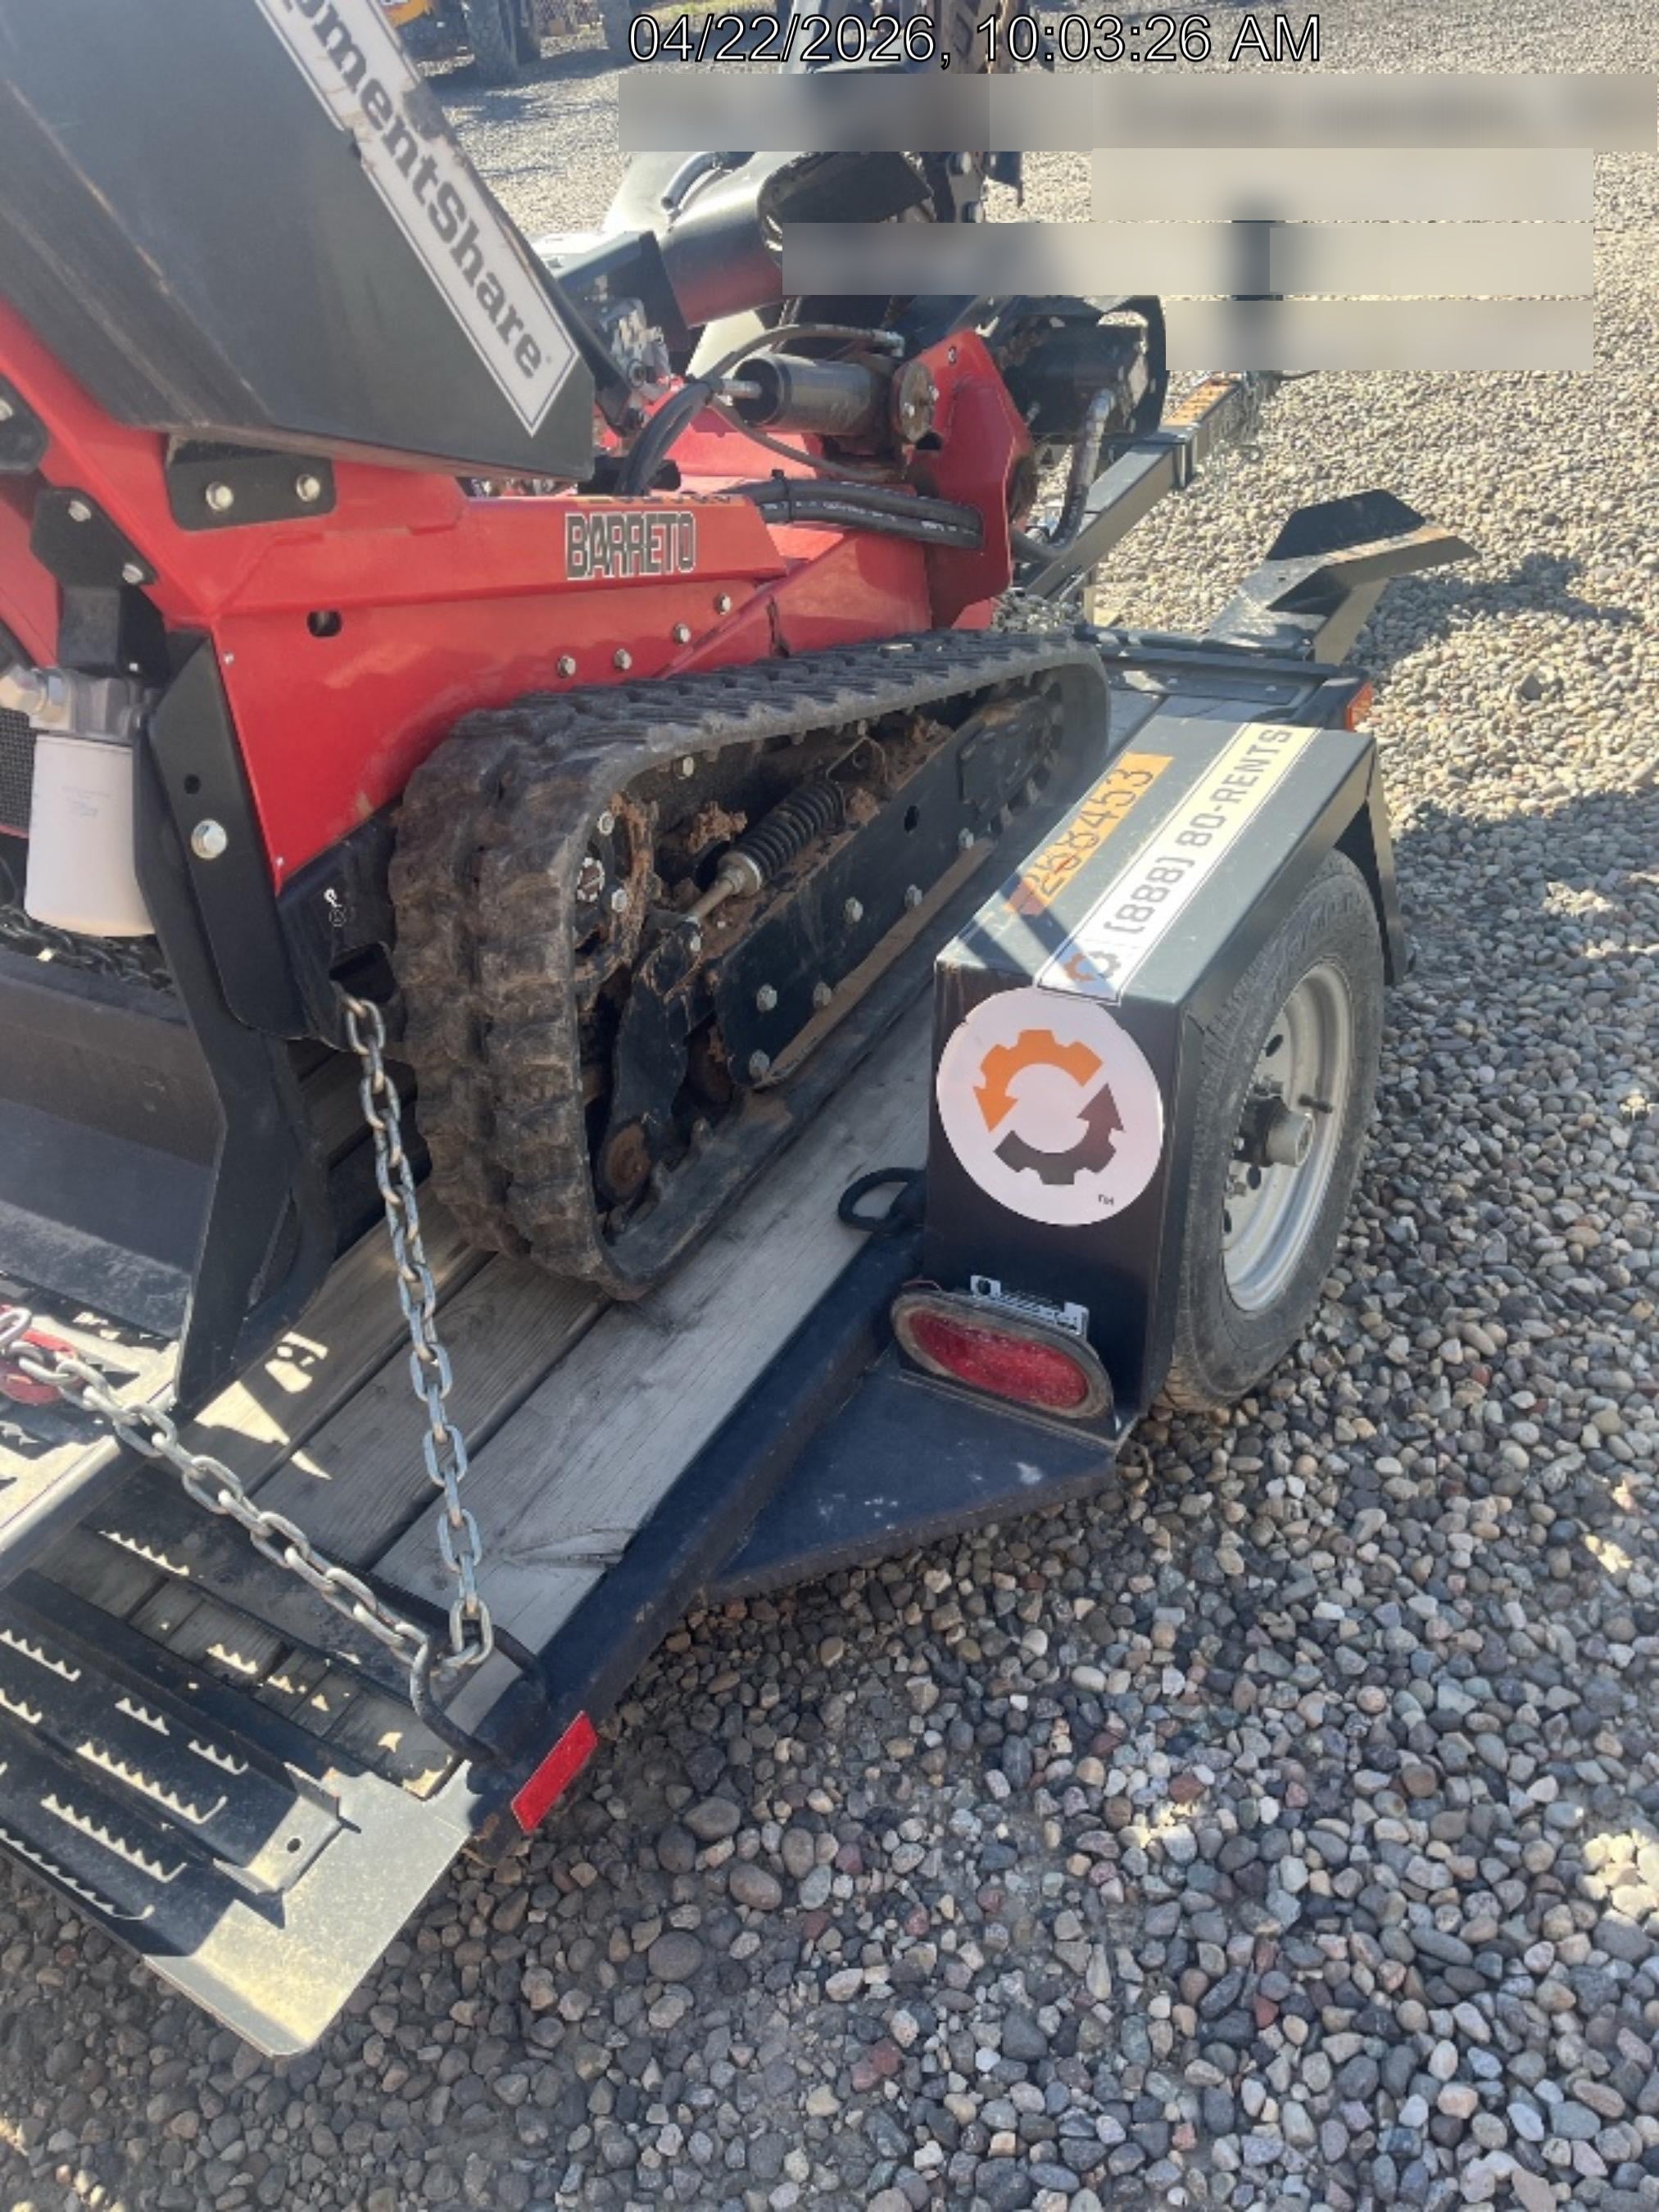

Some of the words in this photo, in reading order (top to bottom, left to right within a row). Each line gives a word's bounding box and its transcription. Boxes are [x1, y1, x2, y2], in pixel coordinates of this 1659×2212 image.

[565, 510, 696, 581] BARRETO
[1104, 856, 1195, 934] (888)
[1175, 728, 1294, 848] 80-RENTS
